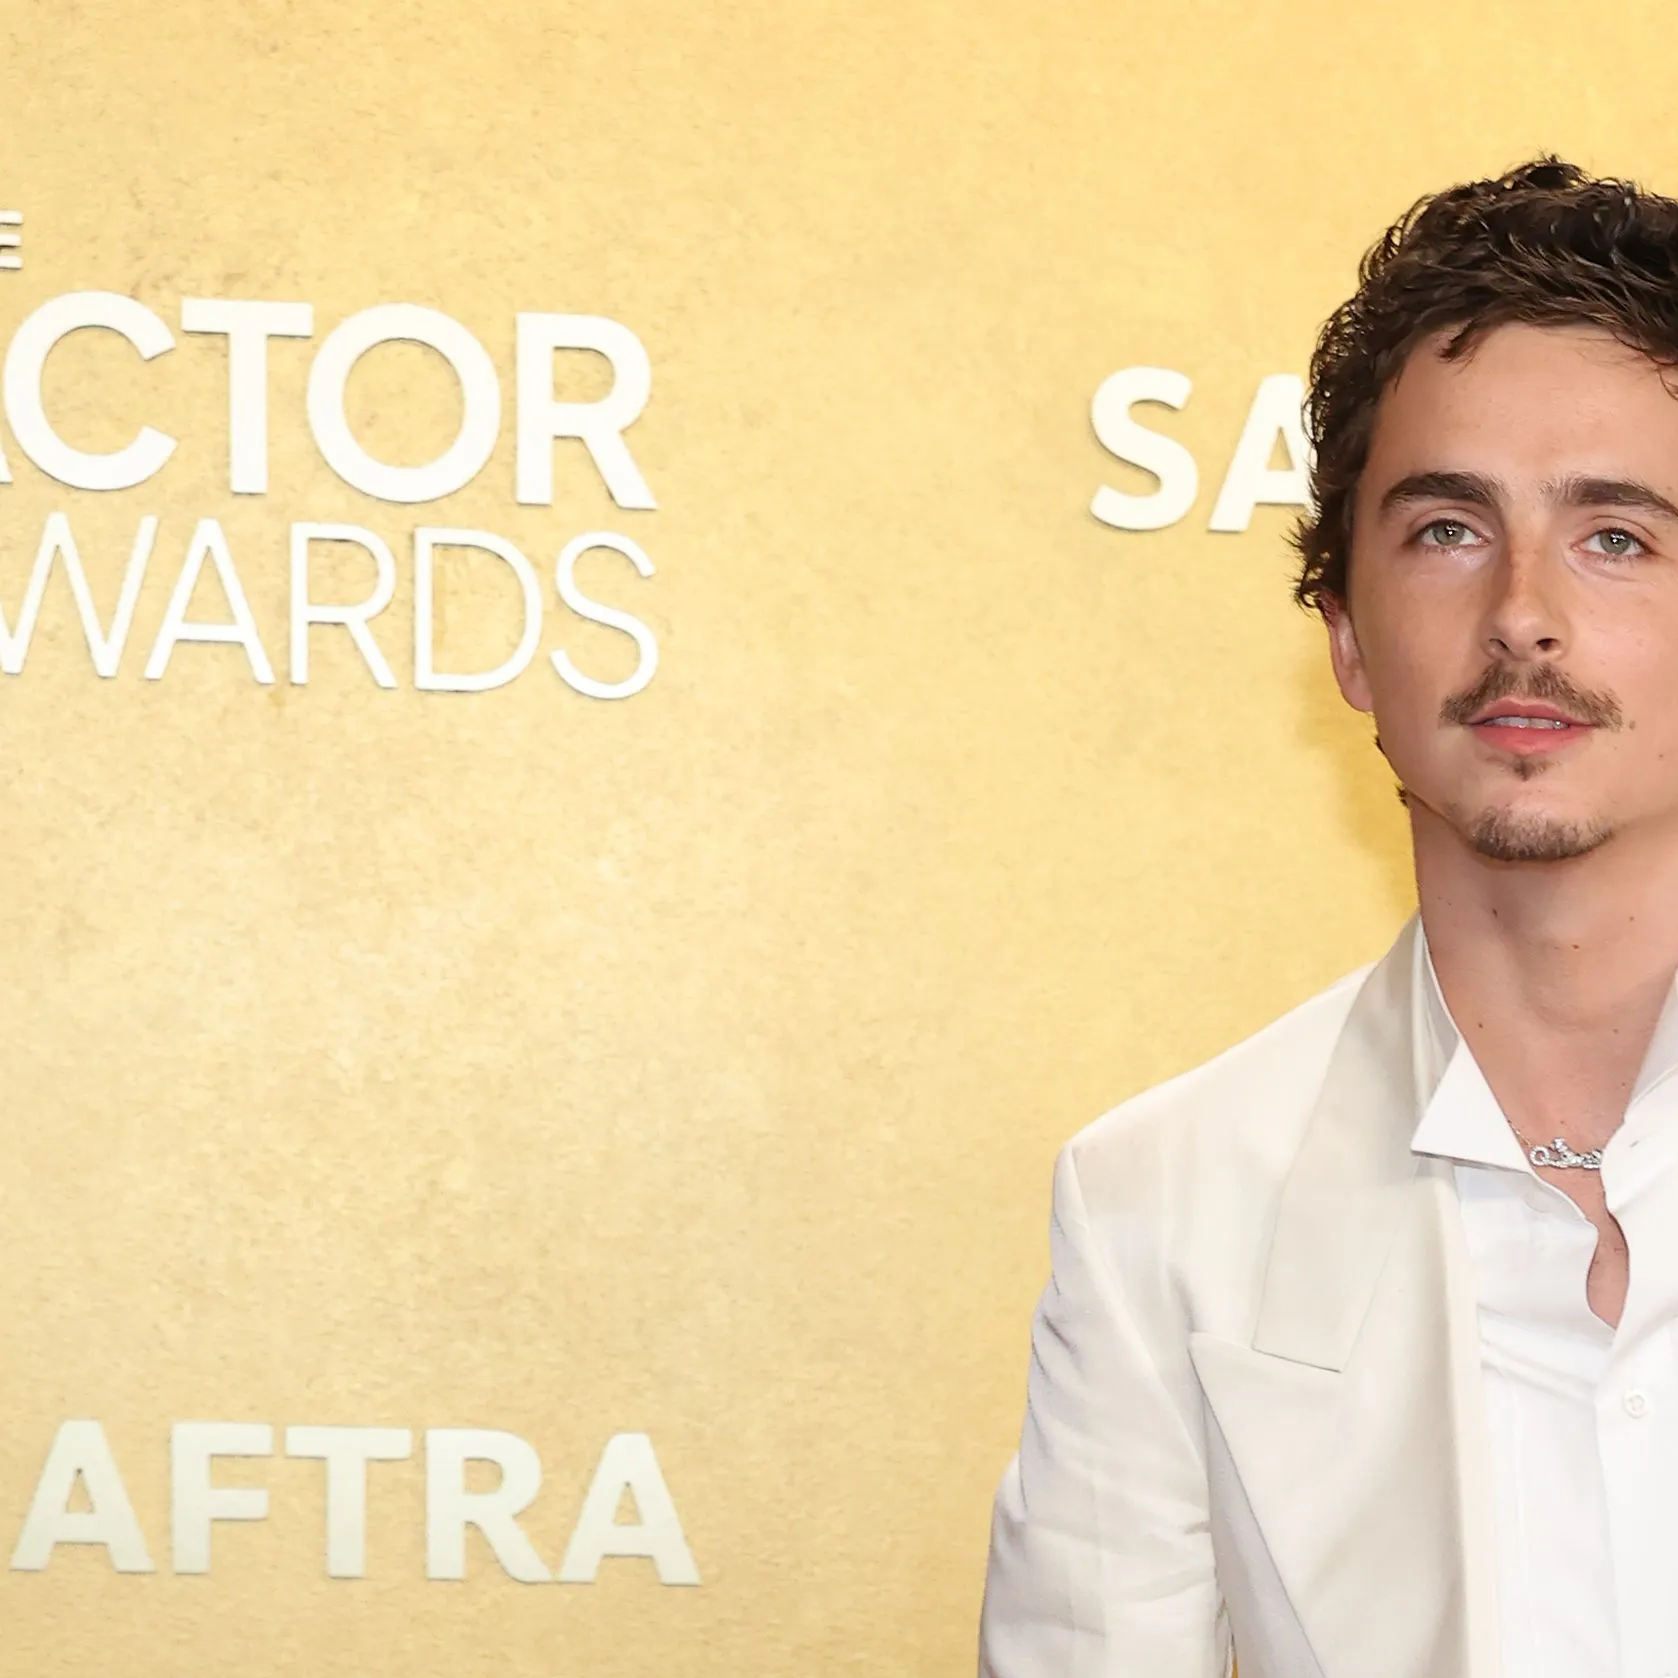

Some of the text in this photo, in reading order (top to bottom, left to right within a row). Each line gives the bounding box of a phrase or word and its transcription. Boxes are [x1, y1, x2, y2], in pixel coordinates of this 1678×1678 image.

[0, 290, 658, 510] CTOR
[0, 511, 659, 700] WARDS
[9, 1419, 702, 1586] AFTRA
